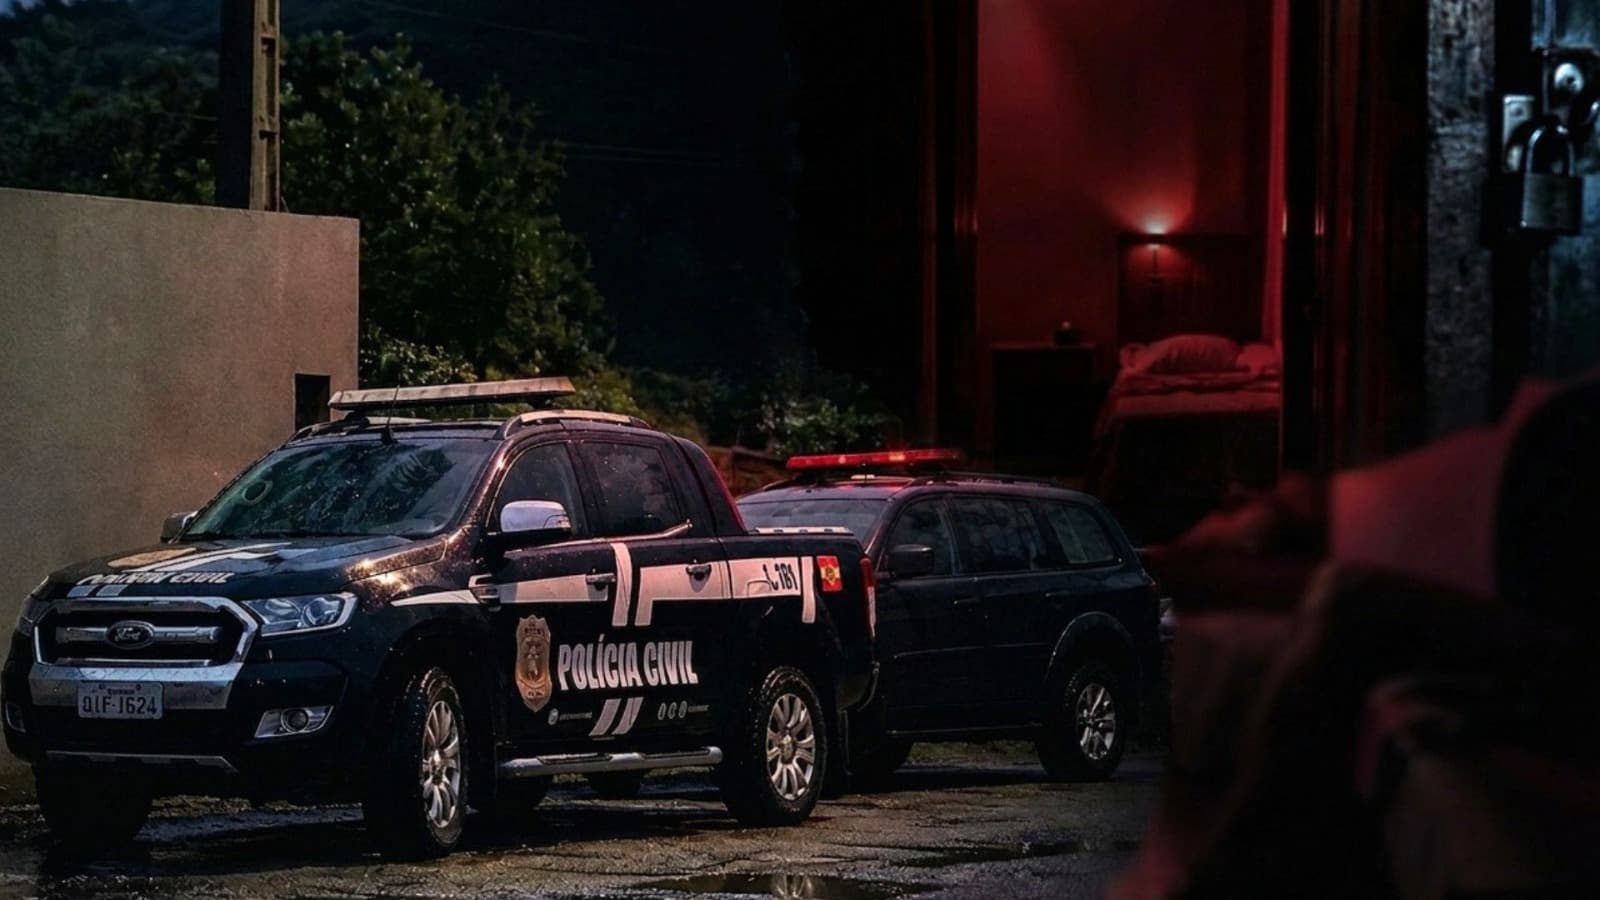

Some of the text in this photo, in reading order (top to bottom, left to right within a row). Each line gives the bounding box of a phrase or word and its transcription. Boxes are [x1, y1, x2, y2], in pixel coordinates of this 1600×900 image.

[114, 626, 142, 642] Ford
[557, 633, 699, 691] POLÍCIA CIVIL
